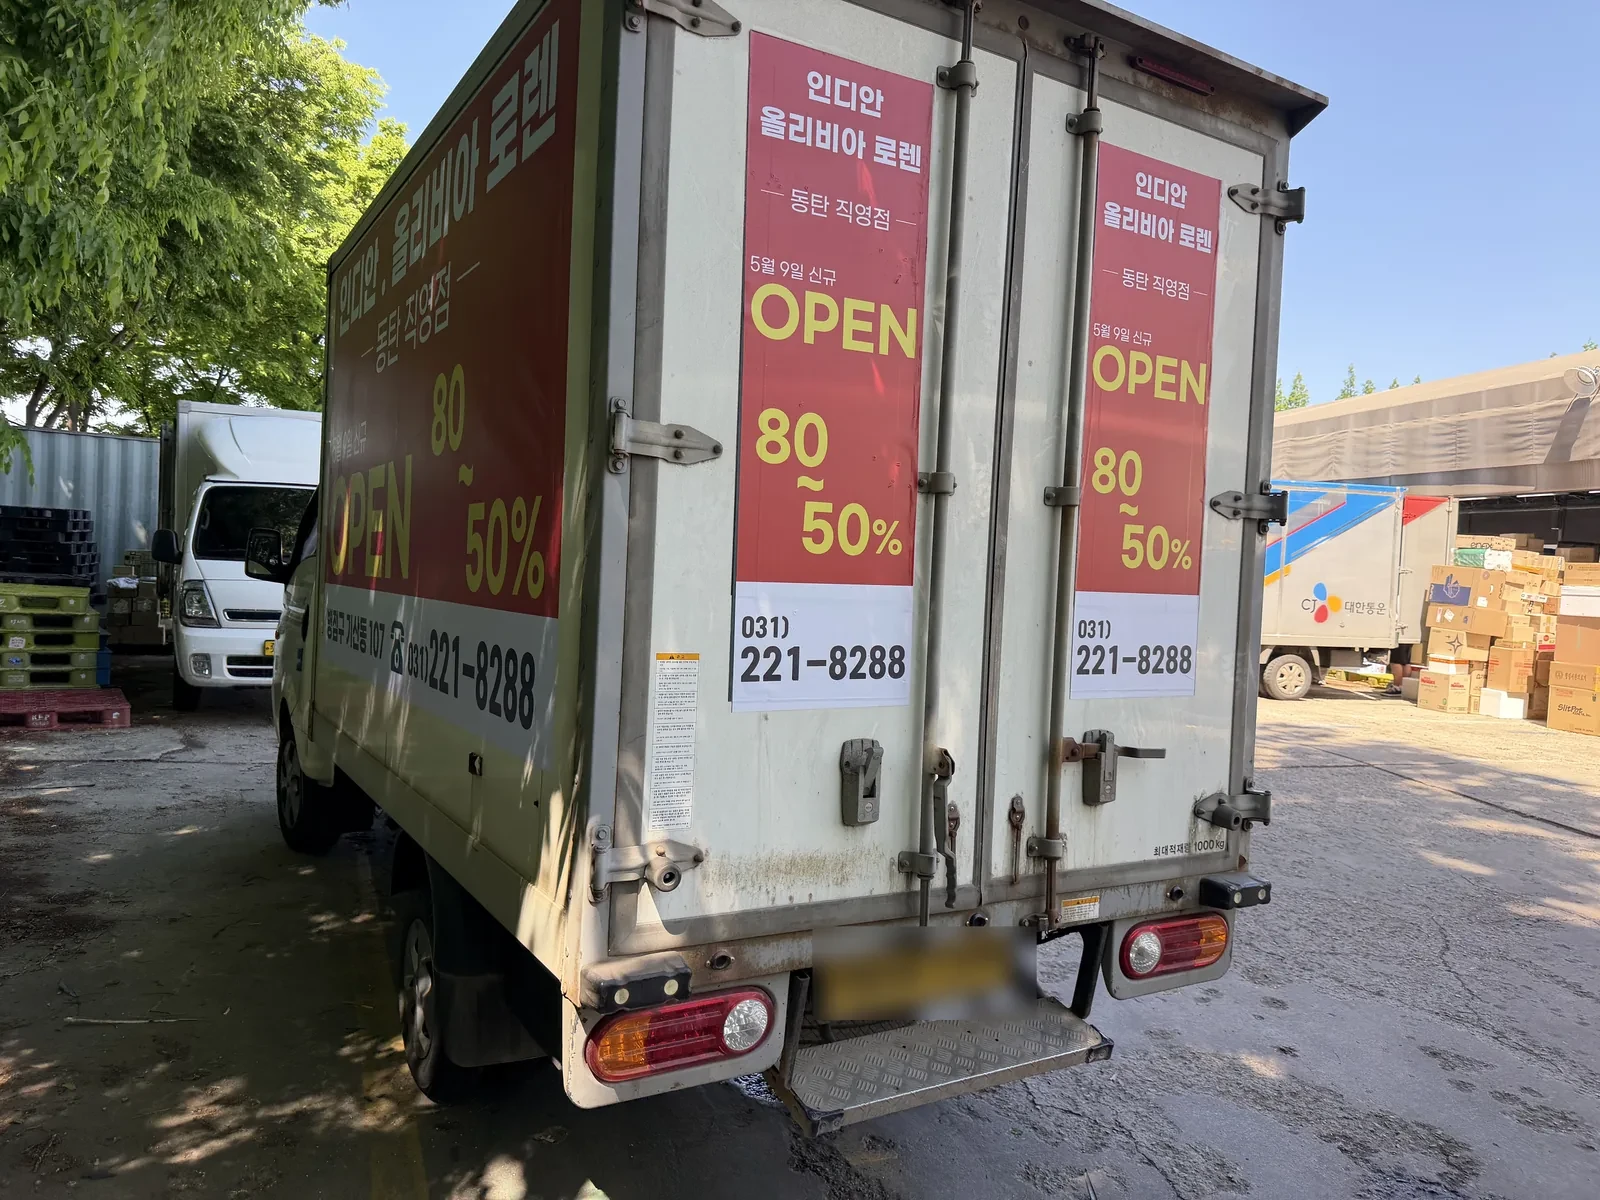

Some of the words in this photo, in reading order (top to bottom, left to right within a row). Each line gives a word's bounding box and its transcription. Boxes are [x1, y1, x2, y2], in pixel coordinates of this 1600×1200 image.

[807, 70, 884, 118] 인디안
[392, 117, 480, 287] 올리비아
[486, 19, 560, 193] 로렌
[760, 105, 866, 160] 올리비아
[873, 135, 921, 174] 로렌
[790, 188, 830, 218] 동탄
[835, 199, 890, 231] 직영점
[1135, 171, 1187, 209] 인디안
[1103, 201, 1174, 243] 올리비아
[1179, 223, 1212, 254] 로렌
[750, 255, 775, 275] 5월
[780, 260, 804, 281] 9일
[809, 266, 837, 287] 신규
[1122, 268, 1148, 291] 동탄
[1152, 275, 1190, 301] 직영점
[376, 306, 400, 374] 동탄
[404, 262, 451, 349] 직영점
[750, 283, 917, 359] OPEN
[1093, 323, 1110, 339] 5월
[1113, 327, 1130, 342] 9일
[1133, 330, 1152, 347] 신규
[1092, 344, 1207, 405] OPEN
[431, 363, 465, 456] 80
[755, 407, 828, 468] 80
[1092, 447, 1143, 496] 80
[330, 454, 412, 579] OPEN
[801, 501, 903, 556] 50%
[465, 495, 545, 600] 50%
[1121, 523, 1192, 570] 50%
[741, 615, 789, 639] 031)
[1078, 620, 1111, 640] 031)
[1301, 598, 1318, 613] CJ
[1344, 601, 1386, 615] 대한통운
[346, 614, 367, 653] 기산동
[369, 620, 385, 659] 107
[1076, 644, 1192, 675] 221-8288
[740, 645, 906, 682] 221-8288
